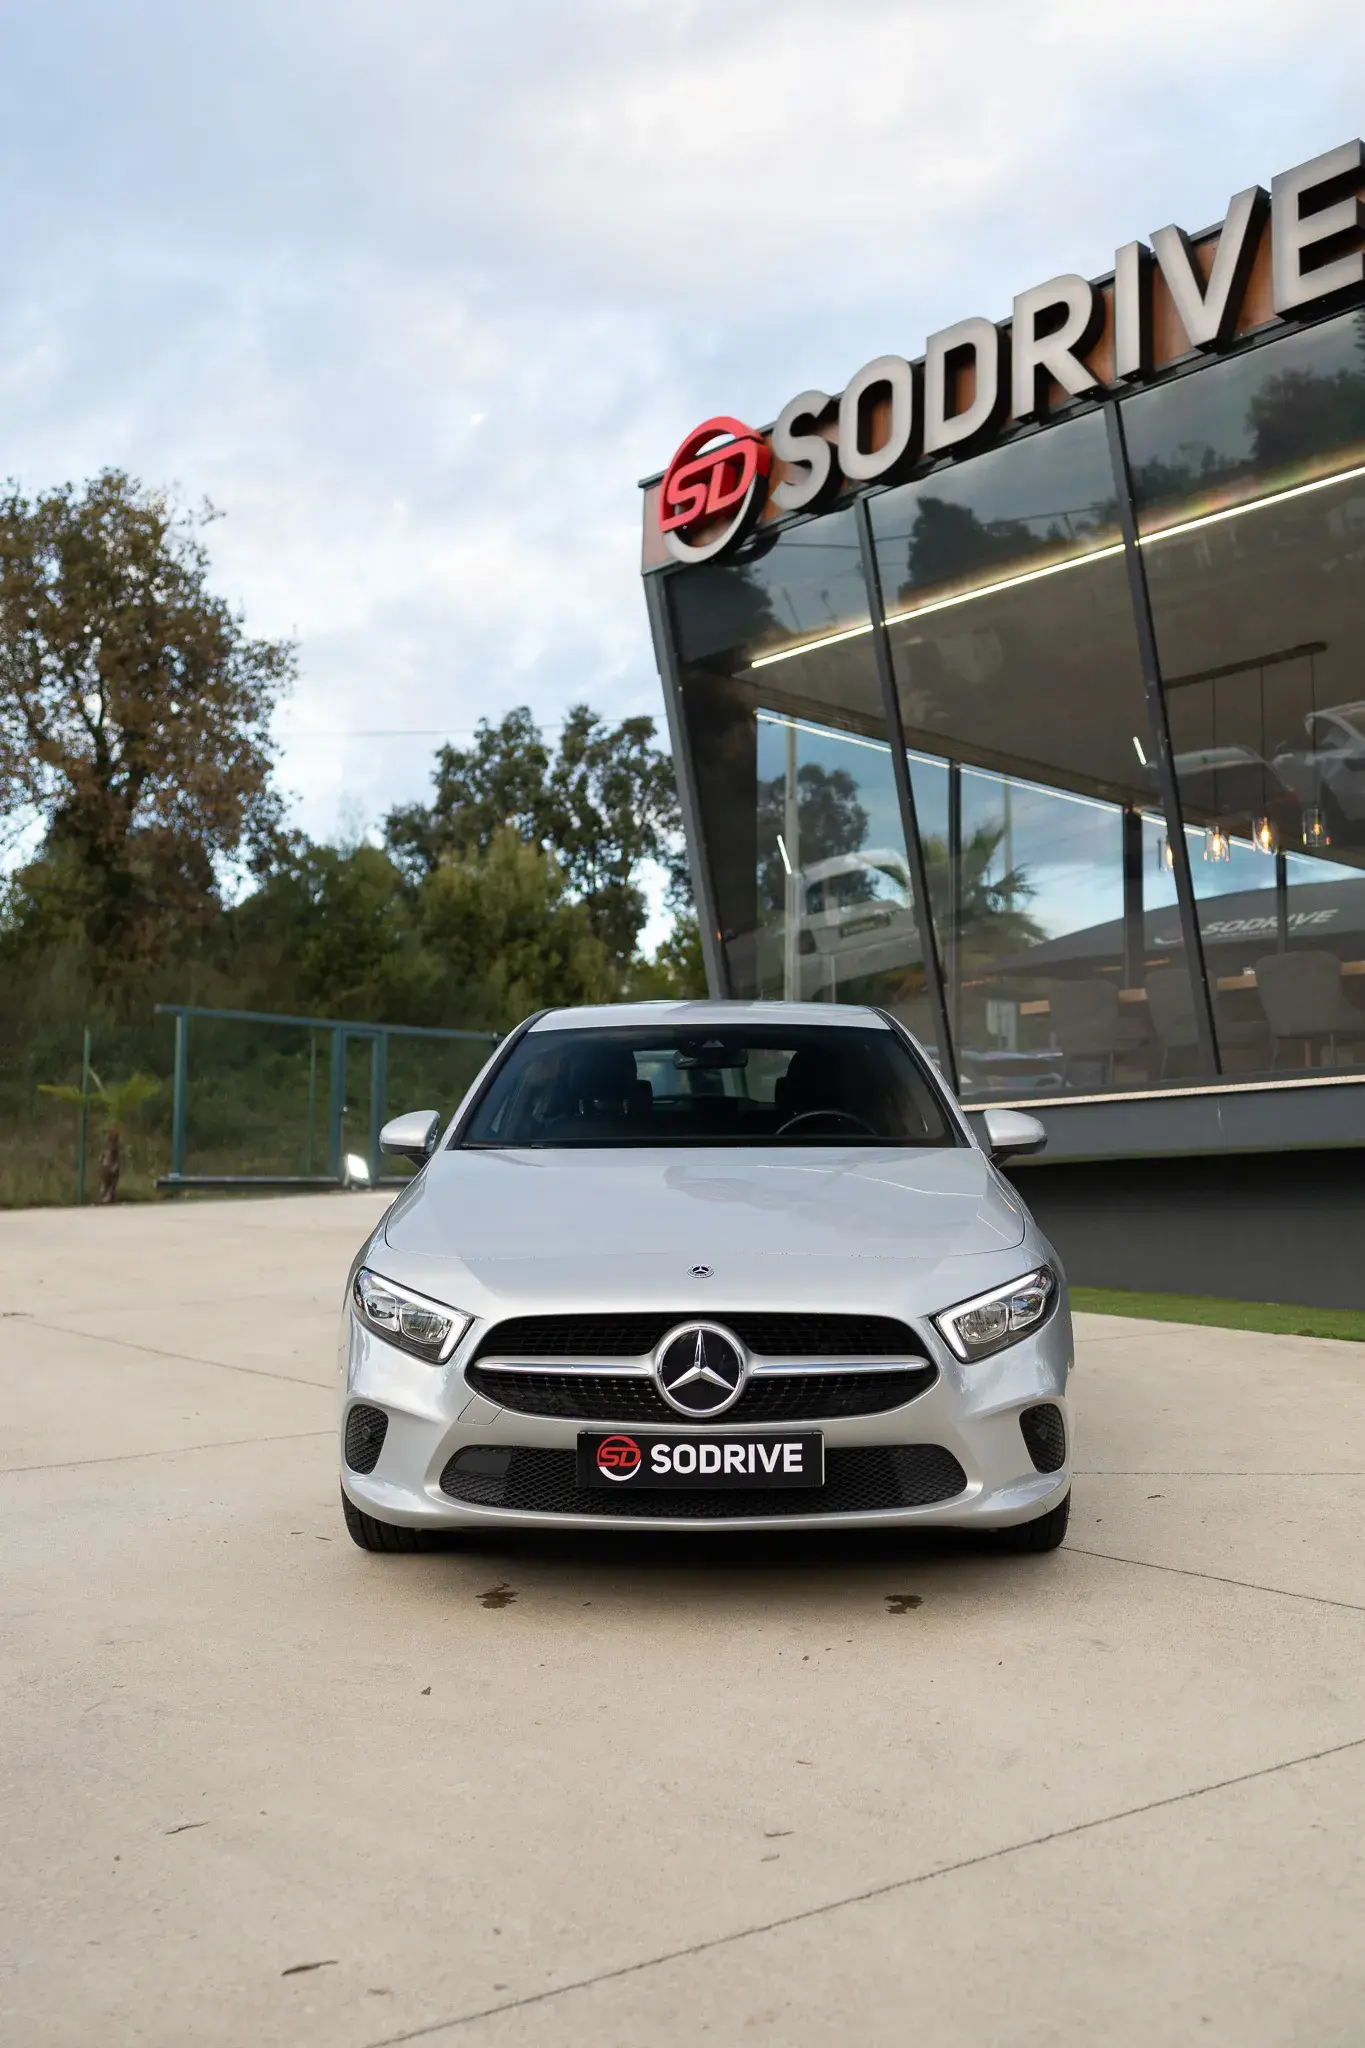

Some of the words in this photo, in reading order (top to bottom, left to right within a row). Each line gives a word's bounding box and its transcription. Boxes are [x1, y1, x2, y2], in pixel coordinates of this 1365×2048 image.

[771, 138, 1365, 511] SODRIVE
[597, 1445, 641, 1468] SD
[650, 1443, 803, 1474] SODRIVE
